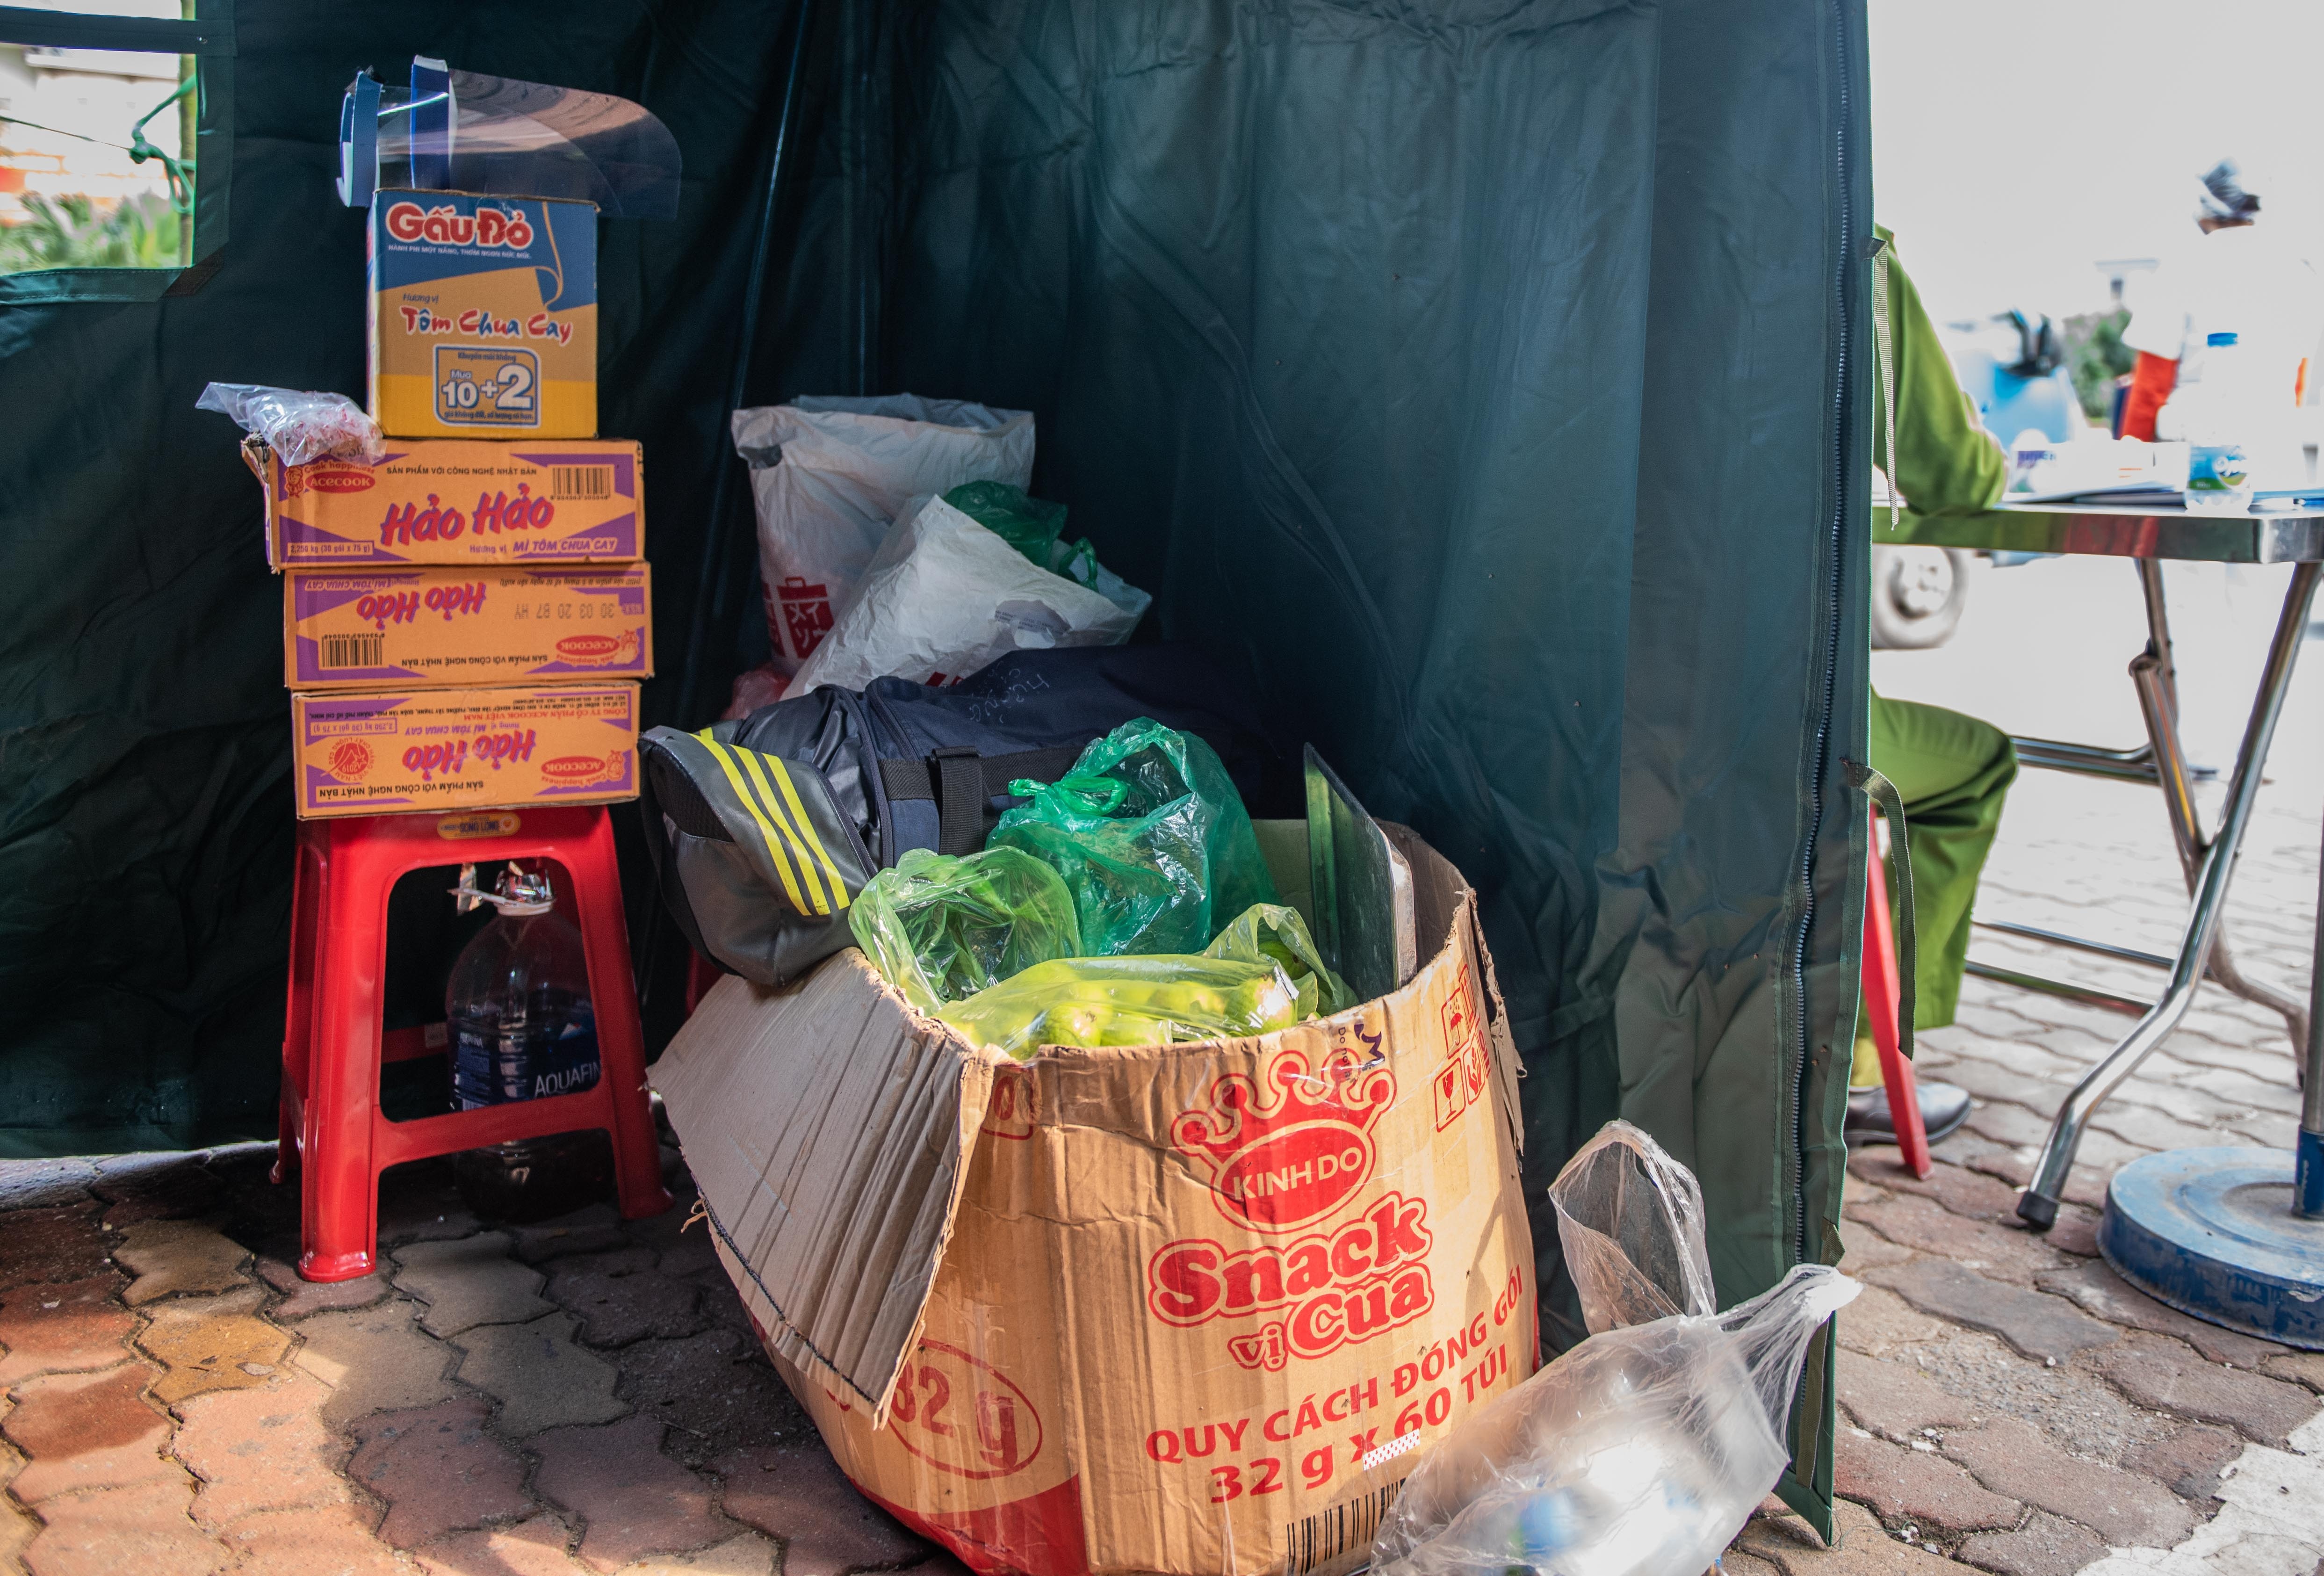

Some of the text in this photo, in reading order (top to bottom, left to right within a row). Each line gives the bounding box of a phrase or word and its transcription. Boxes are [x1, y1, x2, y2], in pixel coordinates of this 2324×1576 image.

[387, 203, 532, 249] Gấu Đỏ
[403, 294, 439, 304] Hương vị
[400, 306, 572, 345] Tôm Chua Cay
[451, 370, 472, 379] Mua
[304, 461, 374, 474] Cook happiness
[387, 464, 537, 476] SẢN PHẨM VỚI CÔNG NGHỆ NHẬT BẢN
[380, 482, 555, 547] Hảo Hảo
[321, 544, 332, 553] (30
[363, 544, 370, 553] g)
[499, 544, 507, 554] vị
[532, 538, 556, 551] TÔM
[561, 539, 591, 551] CHUA
[594, 539, 617, 550] CAY
[306, 580, 372, 590] TÔM CHUA CAY
[356, 582, 486, 630] Hảo Hảo
[579, 603, 593, 619] 03
[600, 603, 615, 619] 30
[557, 603, 572, 620] 20
[402, 658, 419, 668] BẢN
[421, 657, 442, 667] NHẬT
[445, 657, 466, 666] NGHỆ
[469, 657, 491, 667] CÔNG
[493, 657, 505, 665] VỚI
[508, 656, 529, 666] PHẨM
[485, 712, 505, 721] VIỆT
[590, 709, 601, 717] TY
[603, 708, 626, 718] CÔNG
[314, 724, 320, 733] g)
[339, 723, 349, 732] gói
[352, 723, 362, 732] (30
[405, 727, 423, 736] CAY
[426, 726, 449, 736] CHUA
[452, 725, 471, 735] TÔM
[402, 729, 536, 781] Hảo Hảo
[342, 764, 358, 773] 2019
[334, 772, 351, 781] NAM
[541, 774, 606, 786] Cook happiness
[319, 781, 484, 800] SẢN PHẨM VỚI CÔNG NGHỆ NHẬT BẢN
[1338, 1027, 1346, 1044] Do
[1233, 1146, 1363, 1200] KINH DO
[1155, 1196, 1429, 1323] Snack
[1231, 1267, 1429, 1369] vị Cua
[1146, 1266, 1523, 1464] QUY CÁCH ĐÓNG GÓI
[892, 1365, 1018, 1469] 32 g
[1210, 1344, 1507, 1504] 32 g x 60 TÚI
